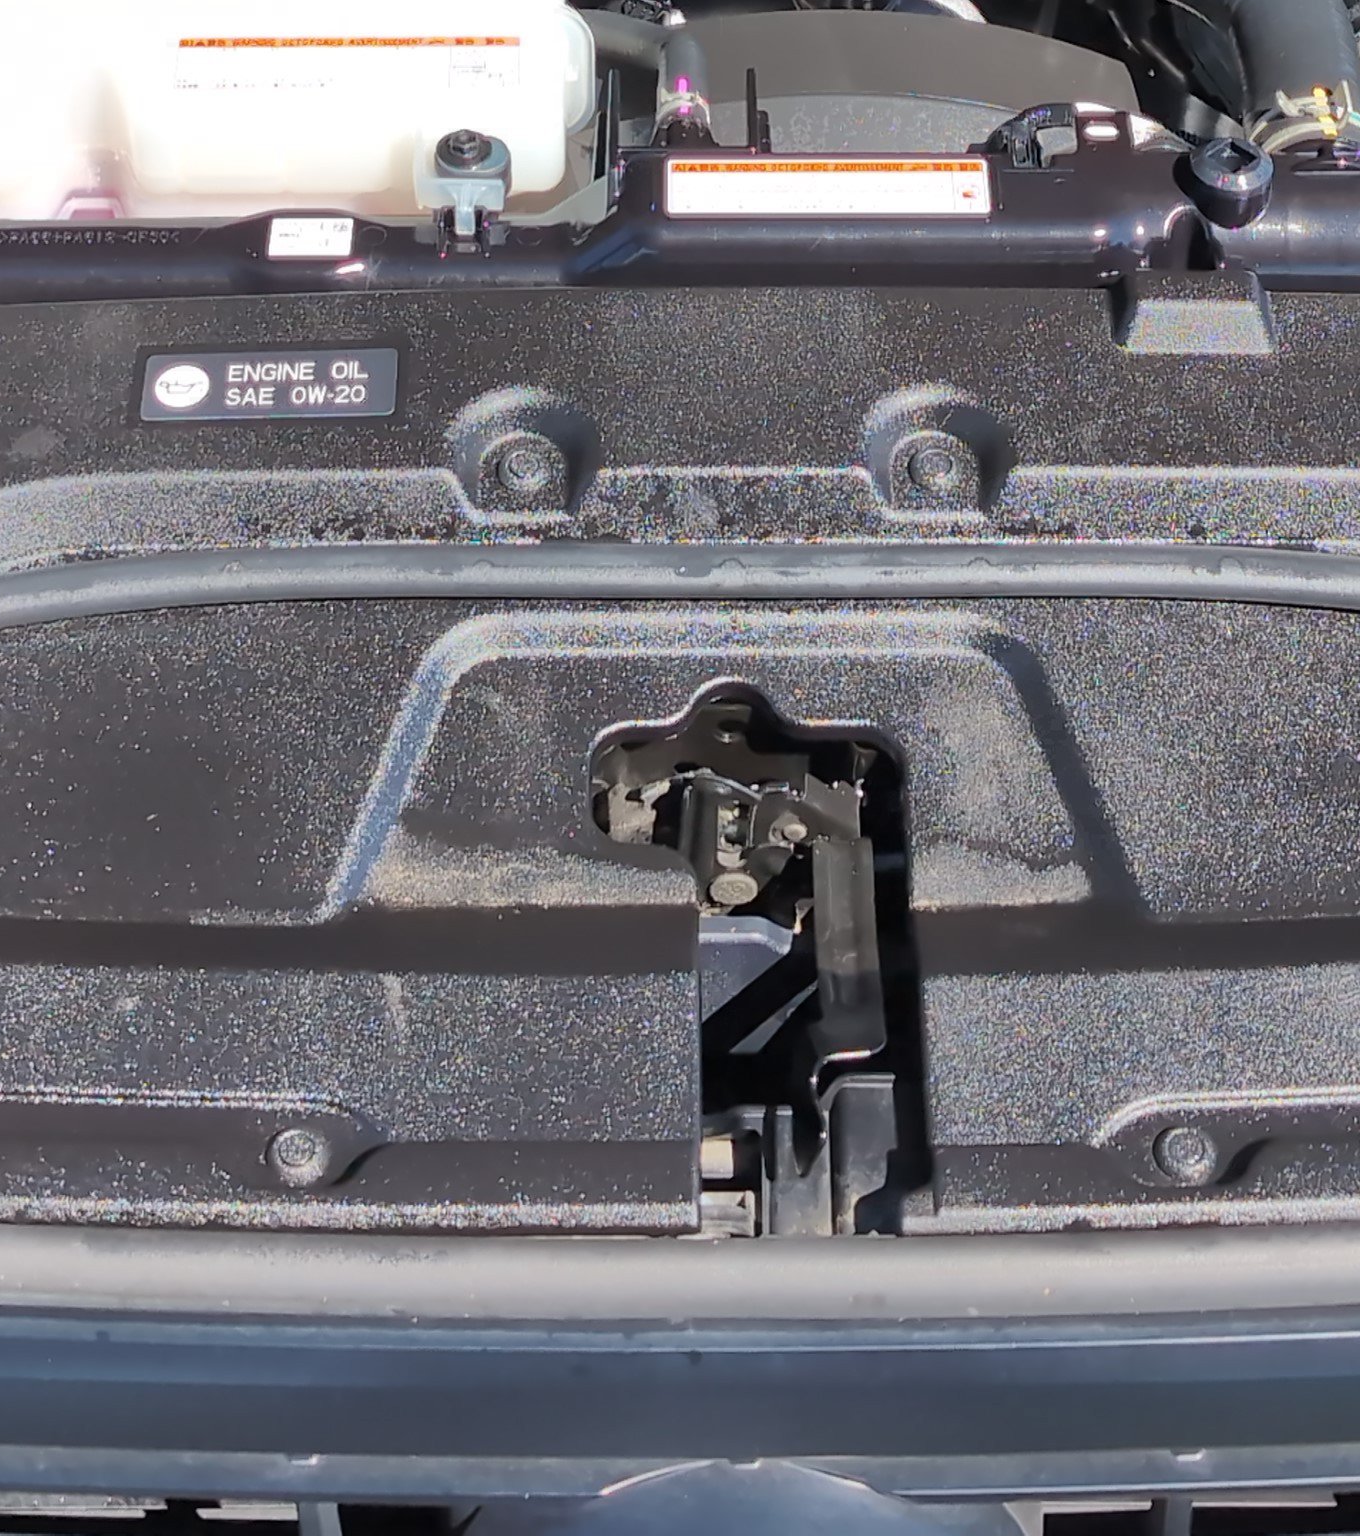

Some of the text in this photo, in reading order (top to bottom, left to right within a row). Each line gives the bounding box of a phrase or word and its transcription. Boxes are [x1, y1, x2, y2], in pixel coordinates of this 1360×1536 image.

[228, 360, 369, 382] ENGINE OIL
[225, 384, 367, 406] SAE 0W-20
